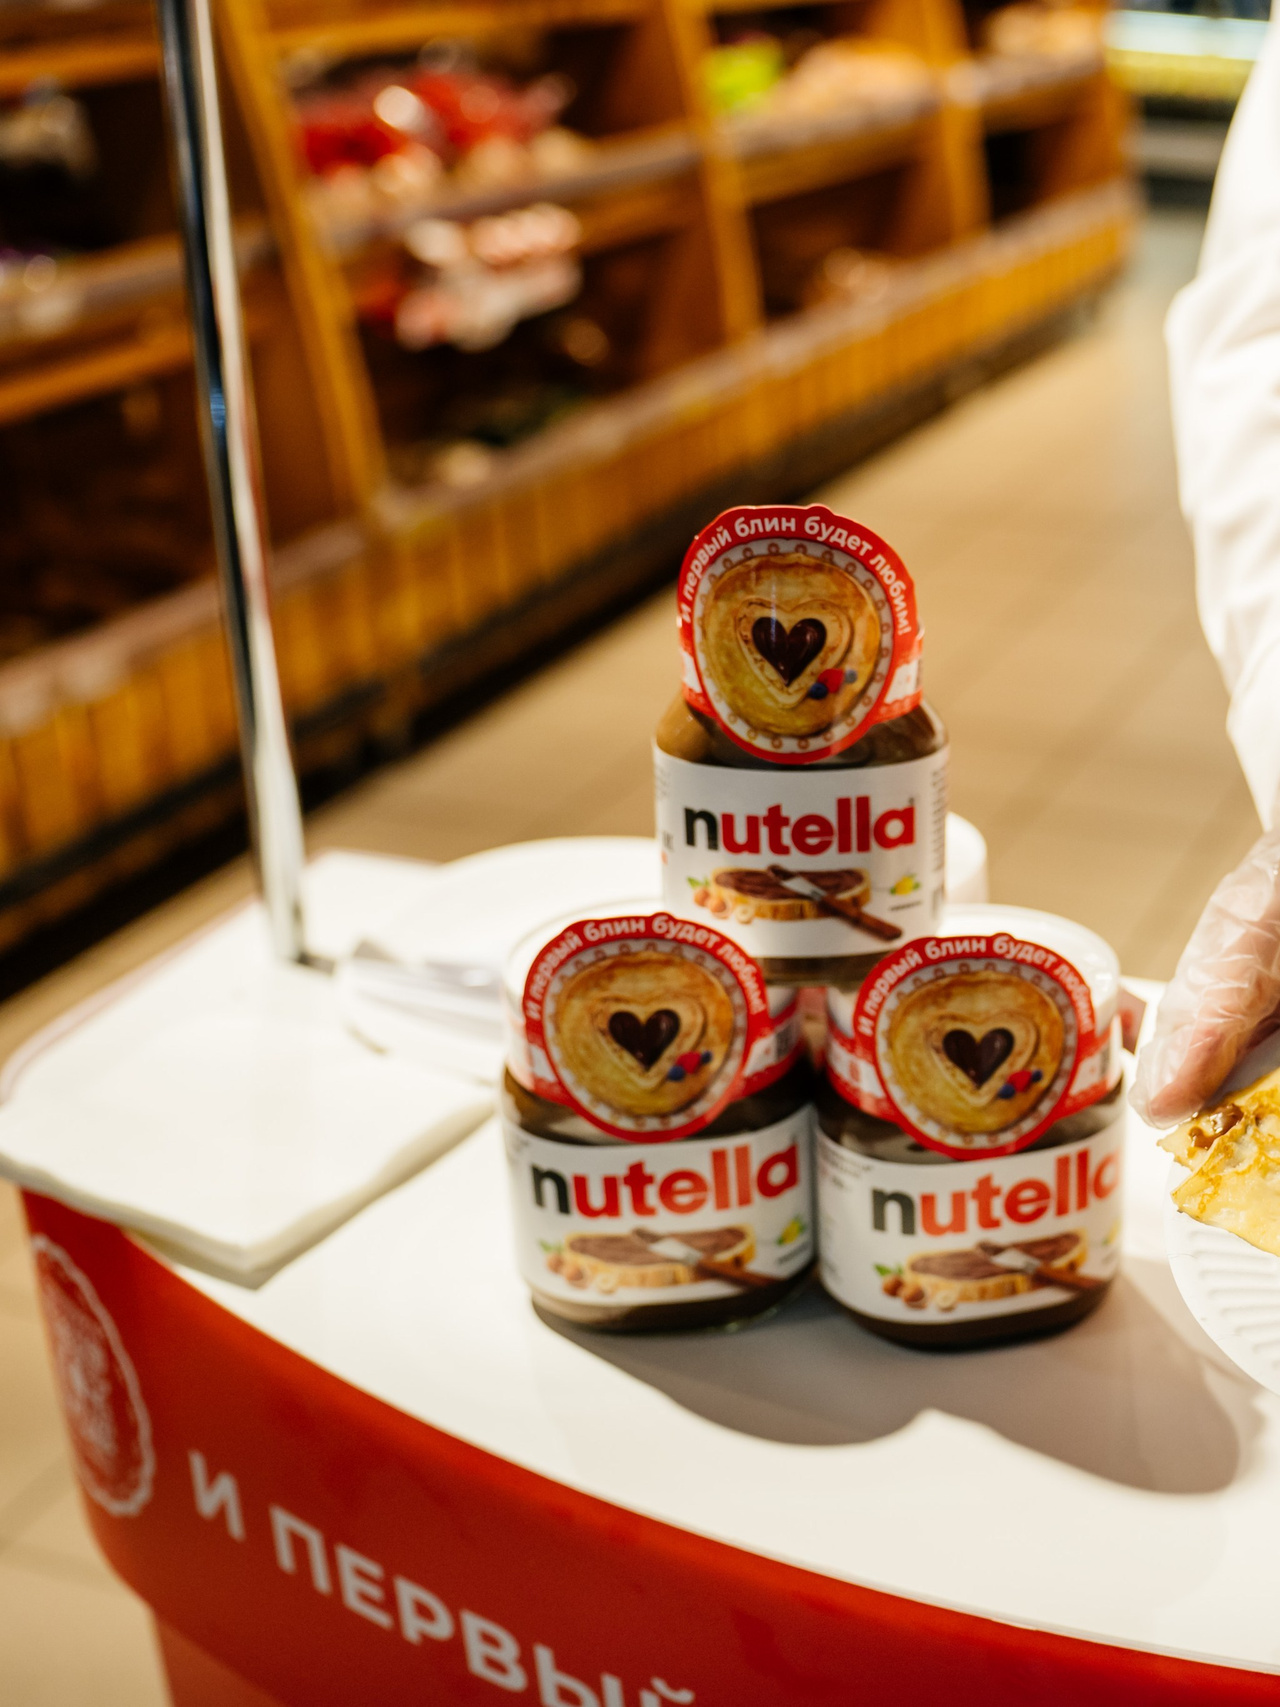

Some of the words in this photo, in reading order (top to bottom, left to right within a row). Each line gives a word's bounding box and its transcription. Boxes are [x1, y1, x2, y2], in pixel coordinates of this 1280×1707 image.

[682, 525, 733, 601] первый
[734, 516, 796, 537] блин
[804, 516, 873, 556] будет
[680, 602, 692, 624] И
[859, 554, 912, 635] любим!
[684, 795, 917, 856] nutella
[529, 930, 583, 1001] первый
[583, 918, 646, 941] блин
[652, 915, 721, 949] будет
[863, 947, 923, 1016] первый
[924, 938, 987, 960] блин
[992, 935, 1057, 969] будет
[531, 1143, 799, 1218] nutella
[872, 1147, 1121, 1236] nutella
[189, 1450, 245, 1542] И
[269, 1505, 696, 1707] ПЕРВЫ
